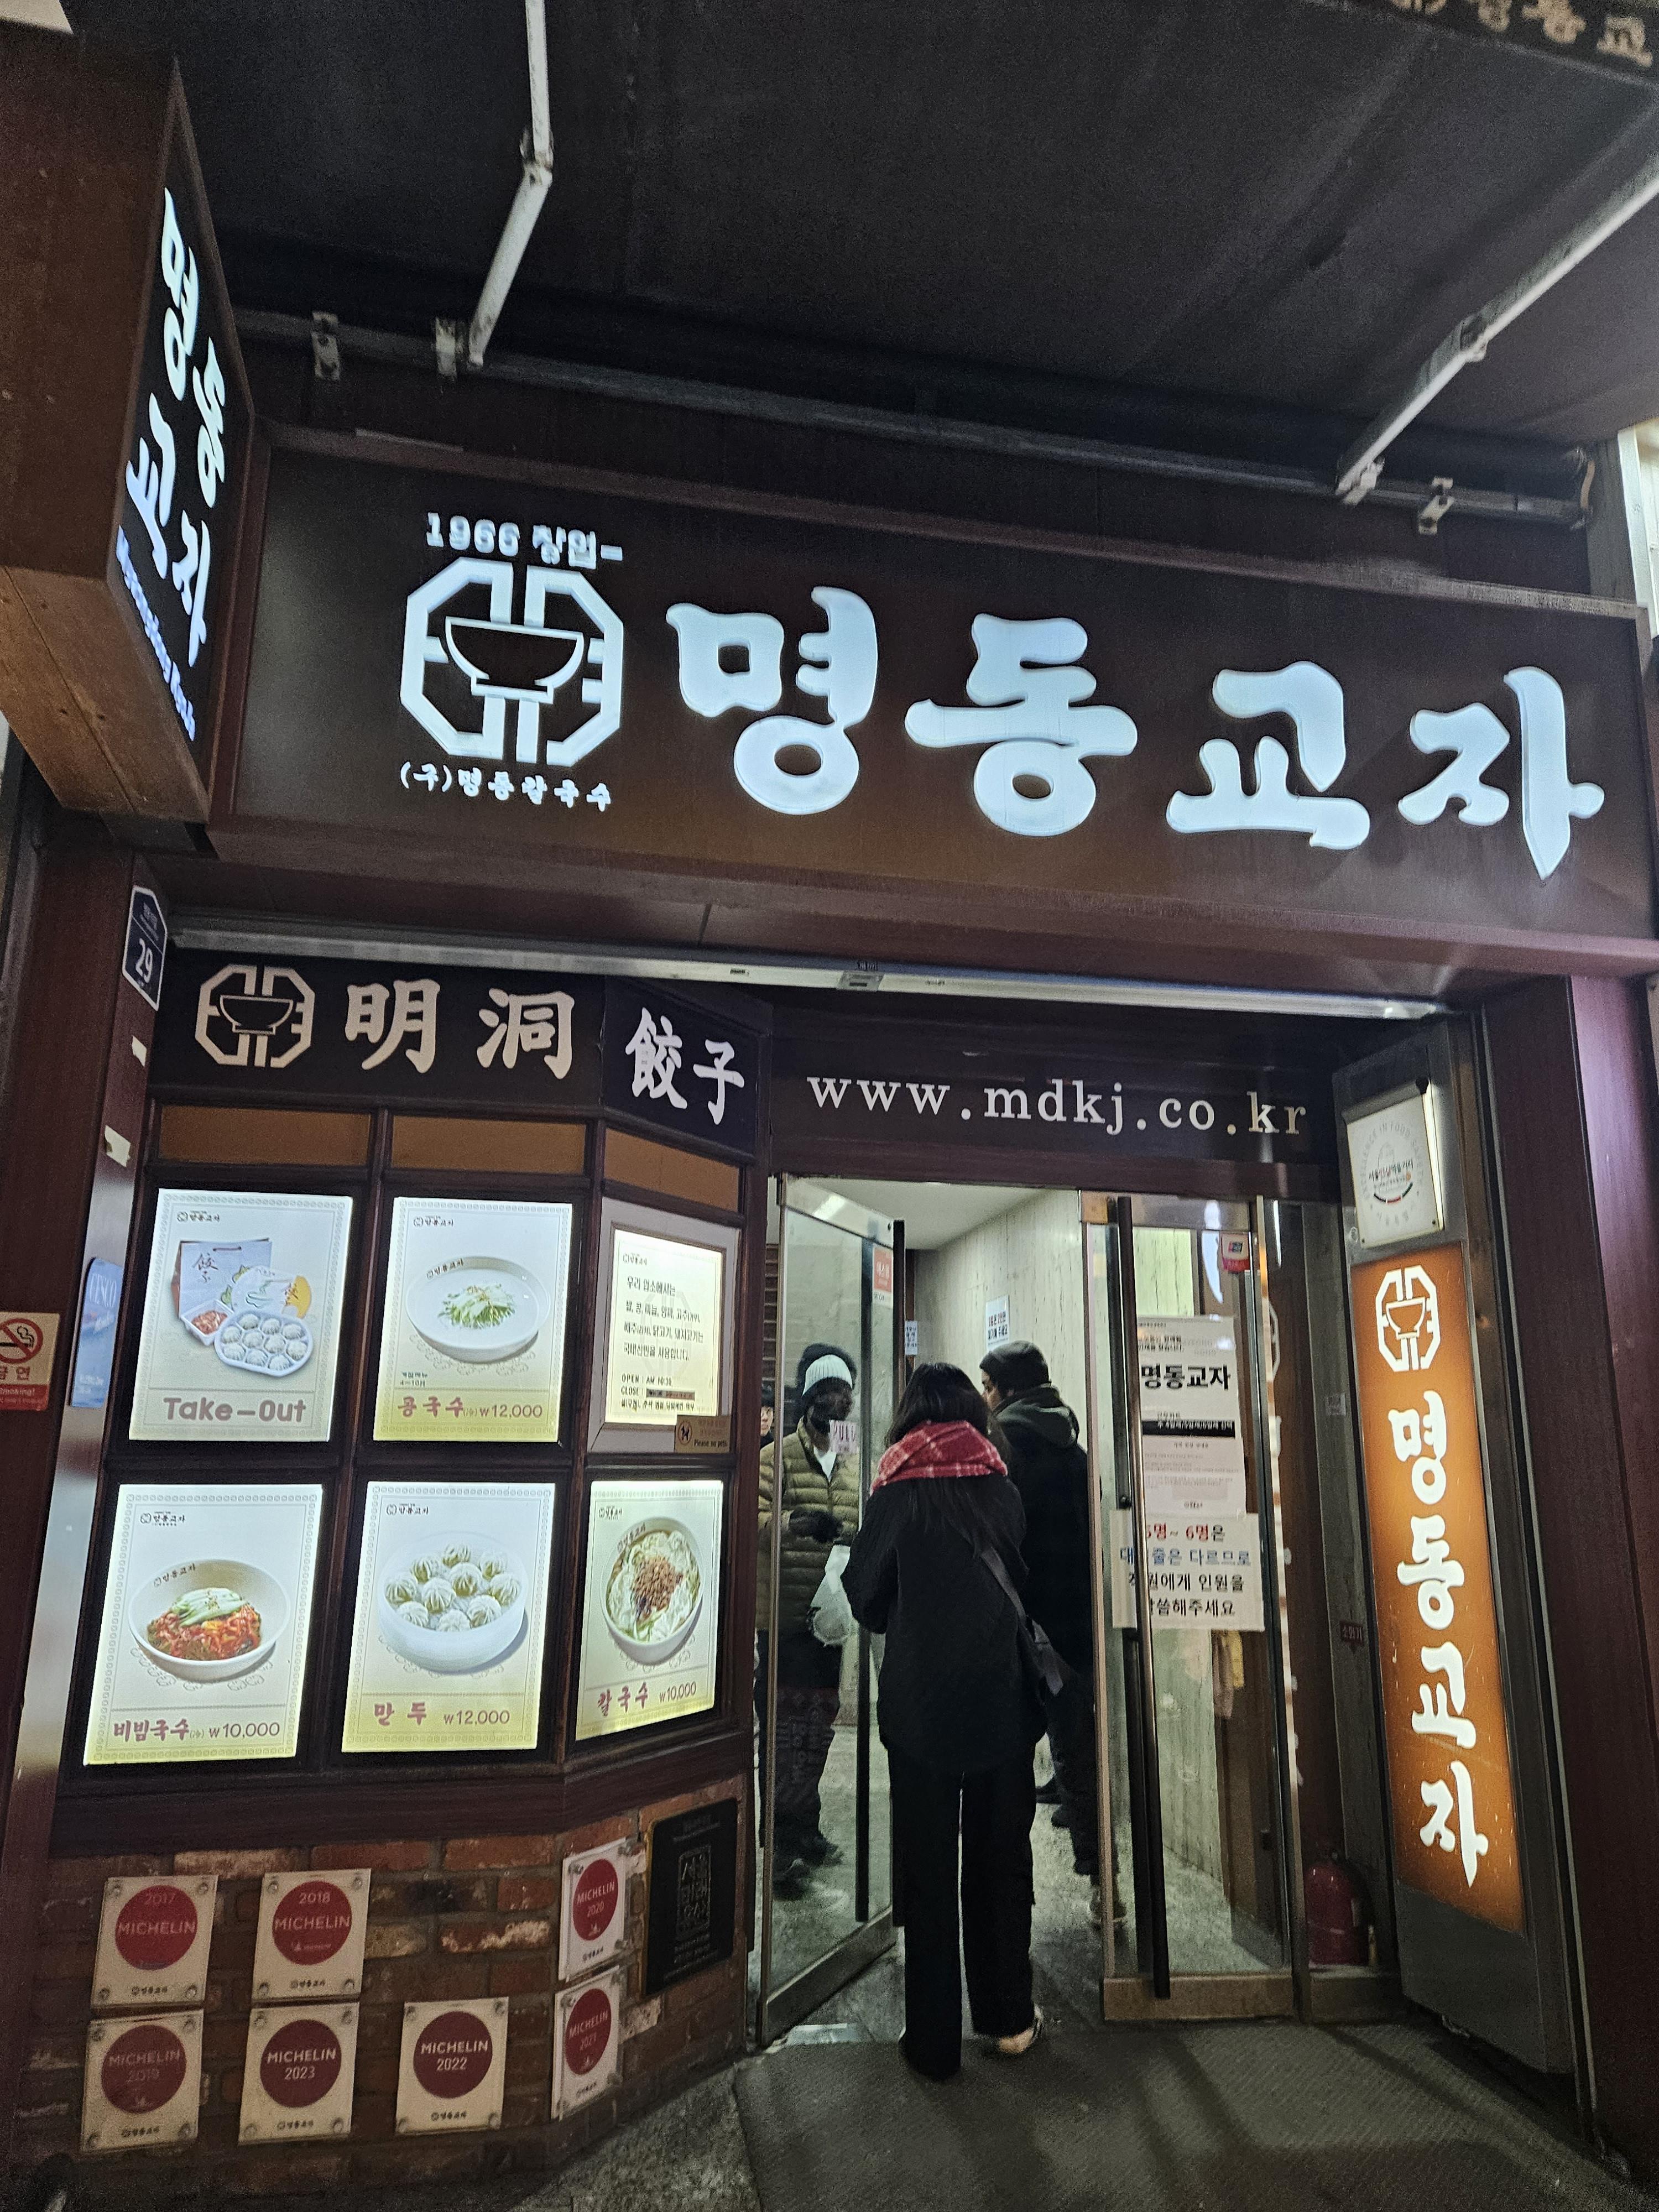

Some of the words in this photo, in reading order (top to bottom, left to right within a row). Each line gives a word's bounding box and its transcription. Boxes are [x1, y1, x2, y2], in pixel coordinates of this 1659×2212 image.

[161, 187, 225, 509] 명동
[126, 393, 211, 668] 교자
[426, 512, 520, 556] 1966
[665, 585, 1605, 881] 명동교자
[135, 938, 153, 984] 29
[806, 1076, 1306, 1136] www.mdkj.co.kr
[628, 1276, 641, 1290] 우리
[643, 1279, 676, 1297] 업소에서는
[622, 1374, 639, 1383] OPEN
[646, 1375, 655, 1385] AM
[1141, 1363, 1231, 1390] 명동교자
[621, 1386, 639, 1395] CLOSE
[1186, 1524, 1225, 1542] 6명은
[1120, 1547, 1182, 1566] 대줄은
[1198, 1573, 1244, 1593] 인원을
[1388, 1390, 1489, 1888] 명동교자
[598, 1682, 648, 1717] 칼국수
[374, 1701, 427, 1726] 만두
[114, 1718, 189, 1742] 비빔국수
[577, 1881, 615, 1905] MICHELIN
[587, 1901, 604, 1918] 2020
[117, 1921, 195, 1935] MICHELIN
[275, 1915, 350, 1931] MICHELIN
[569, 2010, 608, 2039] MICHELIN
[109, 2049, 180, 2066] MICHELIN
[267, 2048, 336, 2064] MICHELIN
[420, 2040, 488, 2054] MICHELIN
[284, 2065, 315, 2080] 2023
[437, 2057, 468, 2071] 2022
